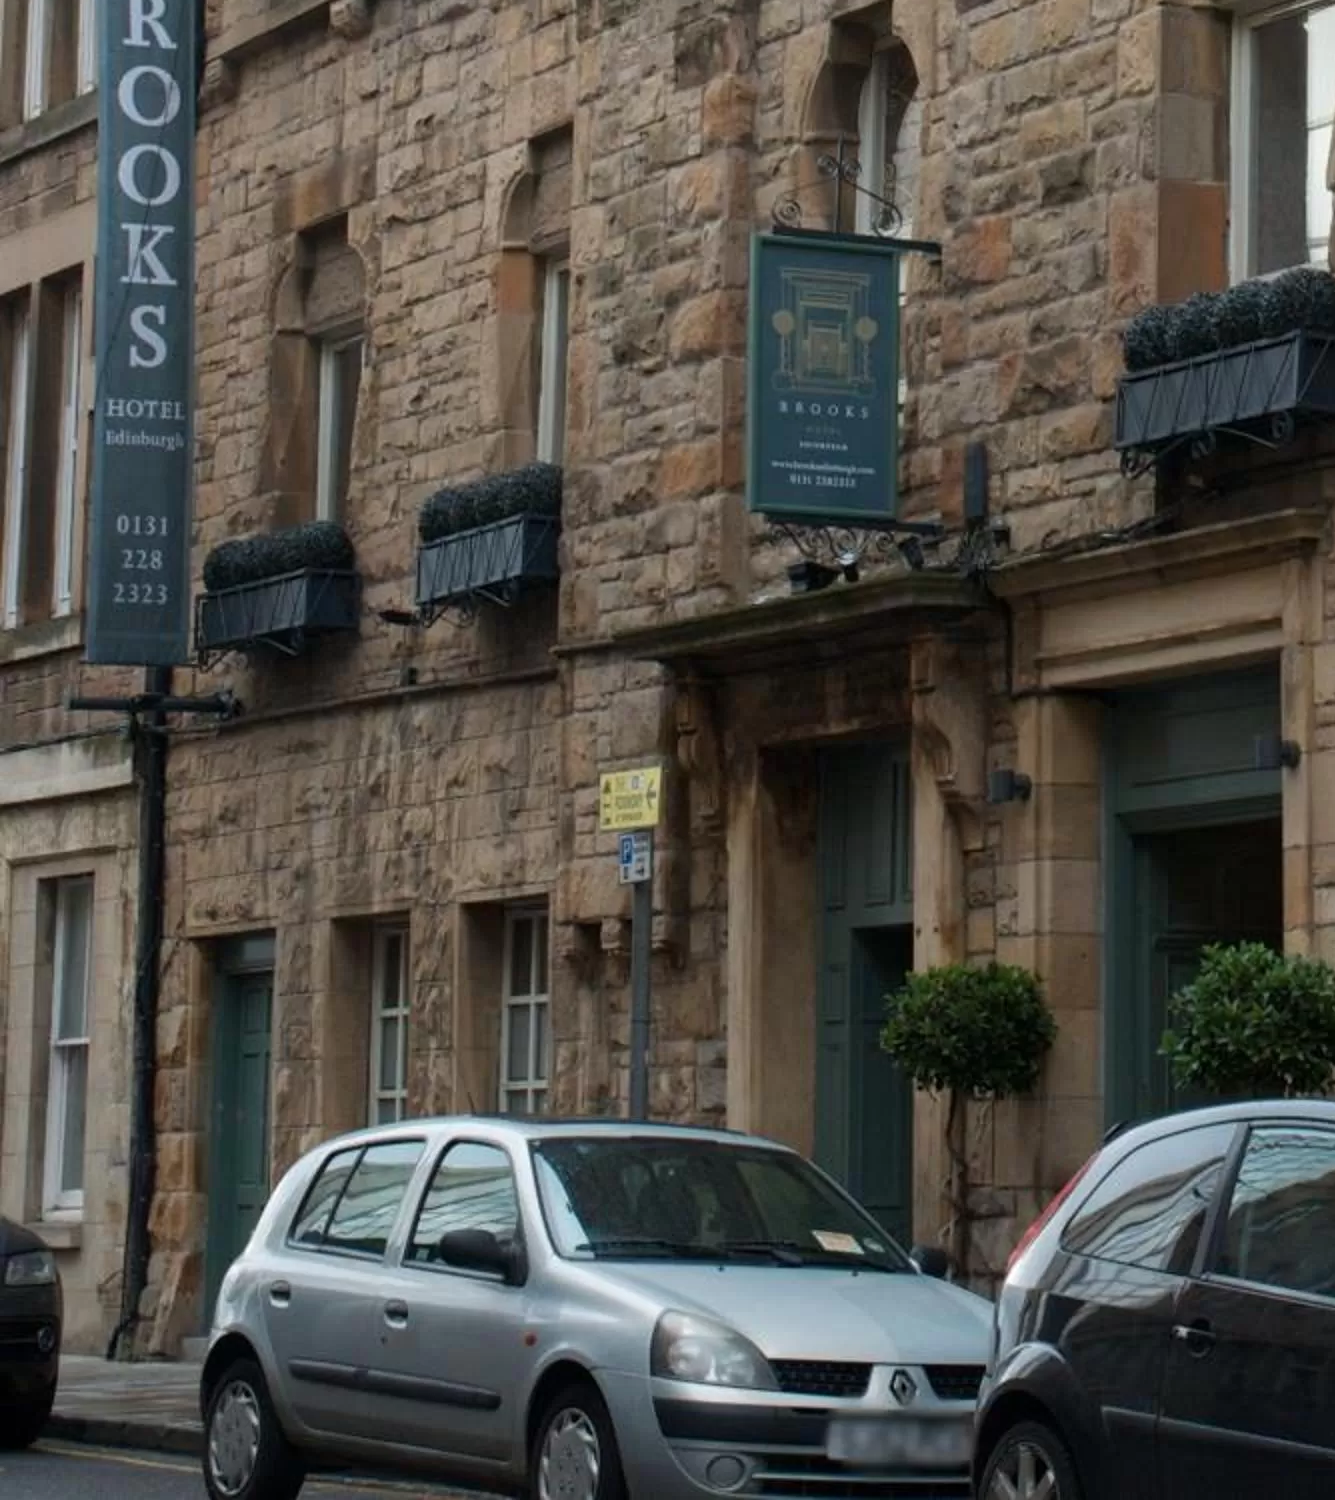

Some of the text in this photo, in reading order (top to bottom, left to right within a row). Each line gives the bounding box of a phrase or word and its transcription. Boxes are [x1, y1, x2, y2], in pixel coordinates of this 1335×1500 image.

[106, 397, 185, 420] HOTEL
[779, 400, 869, 419] BROOKS
[106, 429, 185, 451] Edinburgh
[116, 514, 169, 537] 0131
[121, 548, 163, 570] 228
[113, 582, 169, 605] 2323
